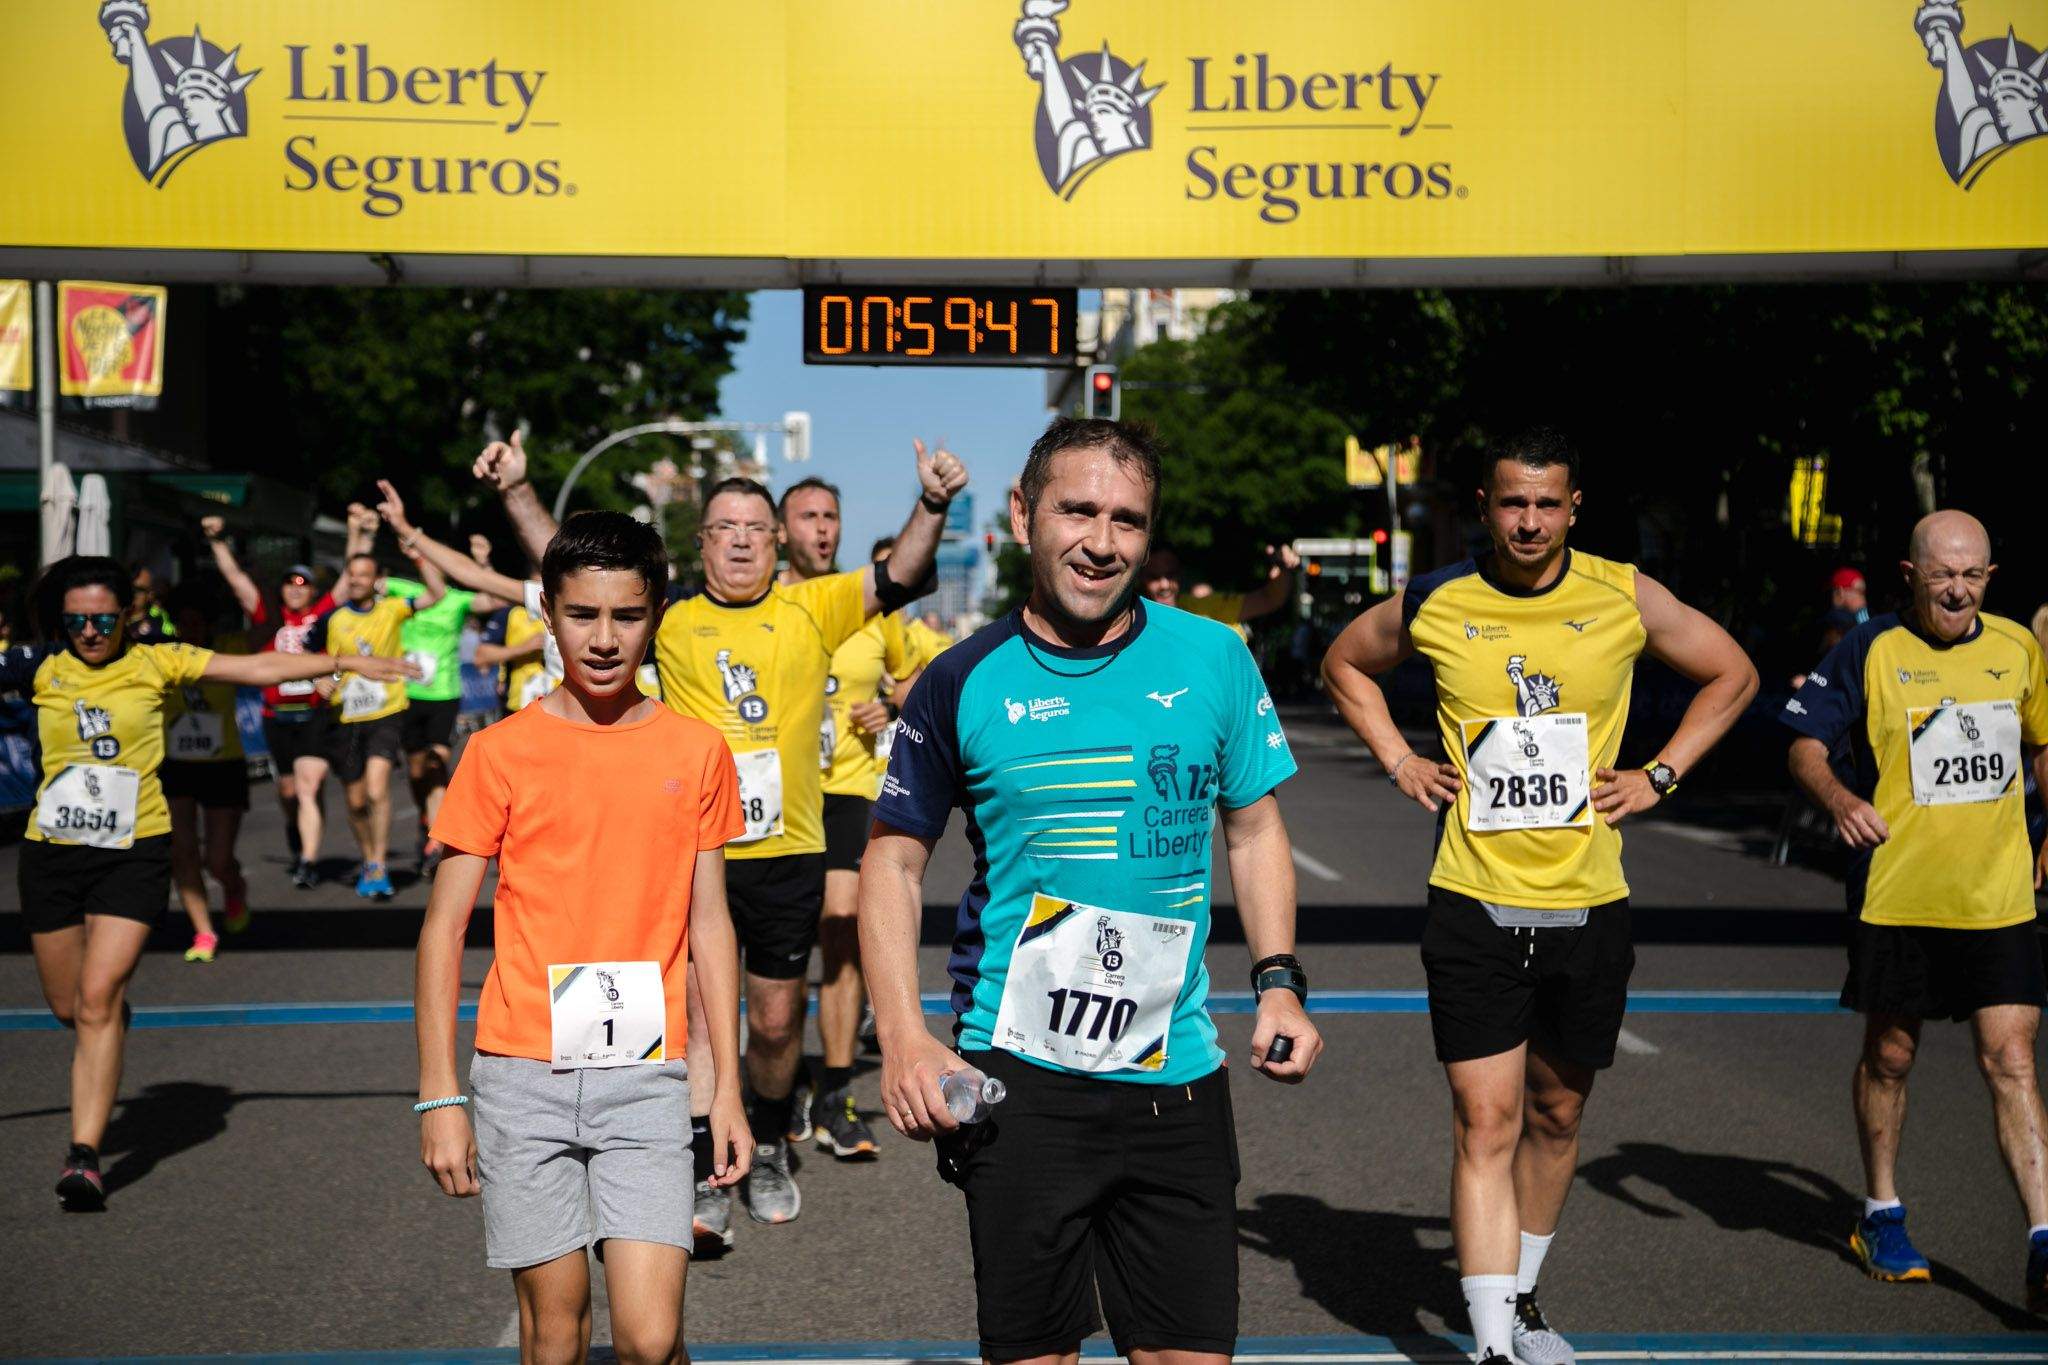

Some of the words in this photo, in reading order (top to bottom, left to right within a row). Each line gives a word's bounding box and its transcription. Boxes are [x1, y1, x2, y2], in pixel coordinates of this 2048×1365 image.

[283, 43, 548, 133] Liberty
[1187, 52, 1442, 137] Liberty
[742, 701, 764, 717] 13
[1028, 696, 1066, 709] Liberty
[1029, 708, 1070, 722] Seguros
[95, 740, 116, 758] 13
[1933, 753, 2004, 786] 2369
[1489, 773, 1569, 810] 2836
[54, 805, 119, 833] 3854
[1144, 805, 1209, 828] Carrera
[1129, 829, 1209, 859] Liberty
[1106, 954, 1120, 968] 13
[1104, 978, 1125, 987] Liberty
[1105, 972, 1126, 980] Carrera
[1047, 987, 1138, 1043] 1770
[603, 1019, 614, 1047] 1
